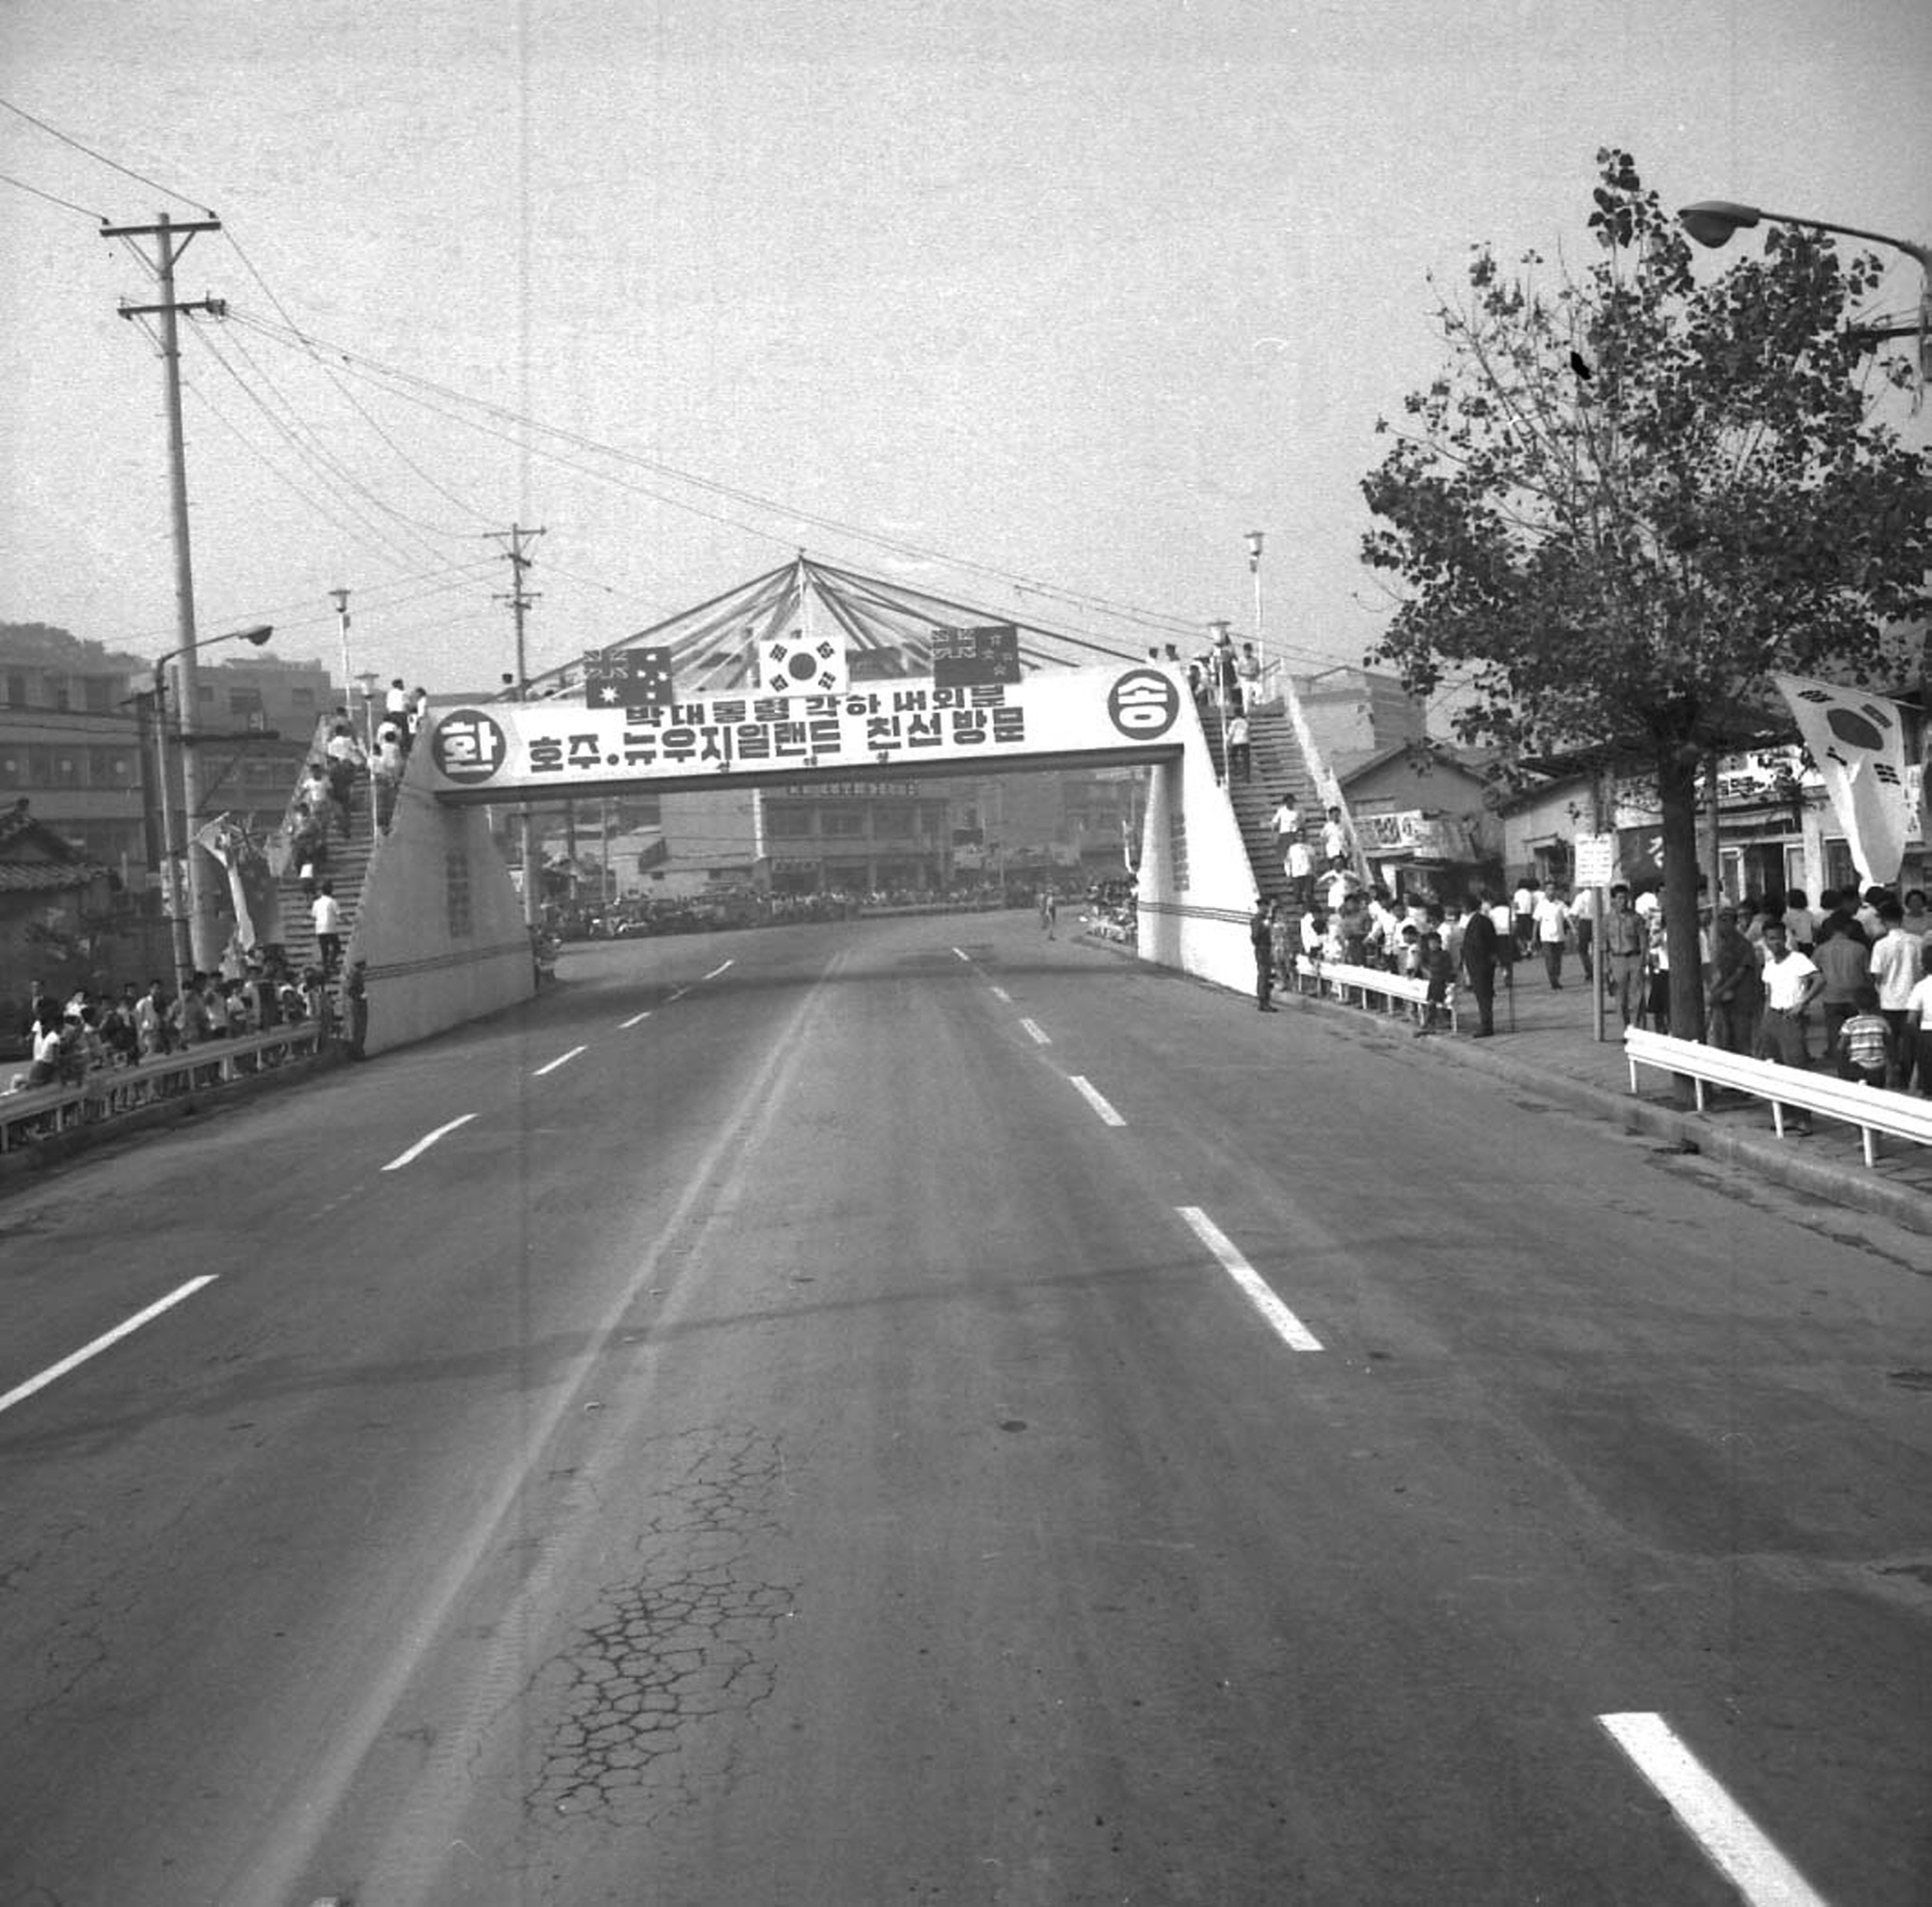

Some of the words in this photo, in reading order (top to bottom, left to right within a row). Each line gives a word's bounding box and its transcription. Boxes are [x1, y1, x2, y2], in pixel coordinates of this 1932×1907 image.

[626, 697, 790, 727] 박대통령
[806, 695, 881, 717] 각하
[1118, 677, 1168, 728] 송
[440, 722, 497, 774] 환
